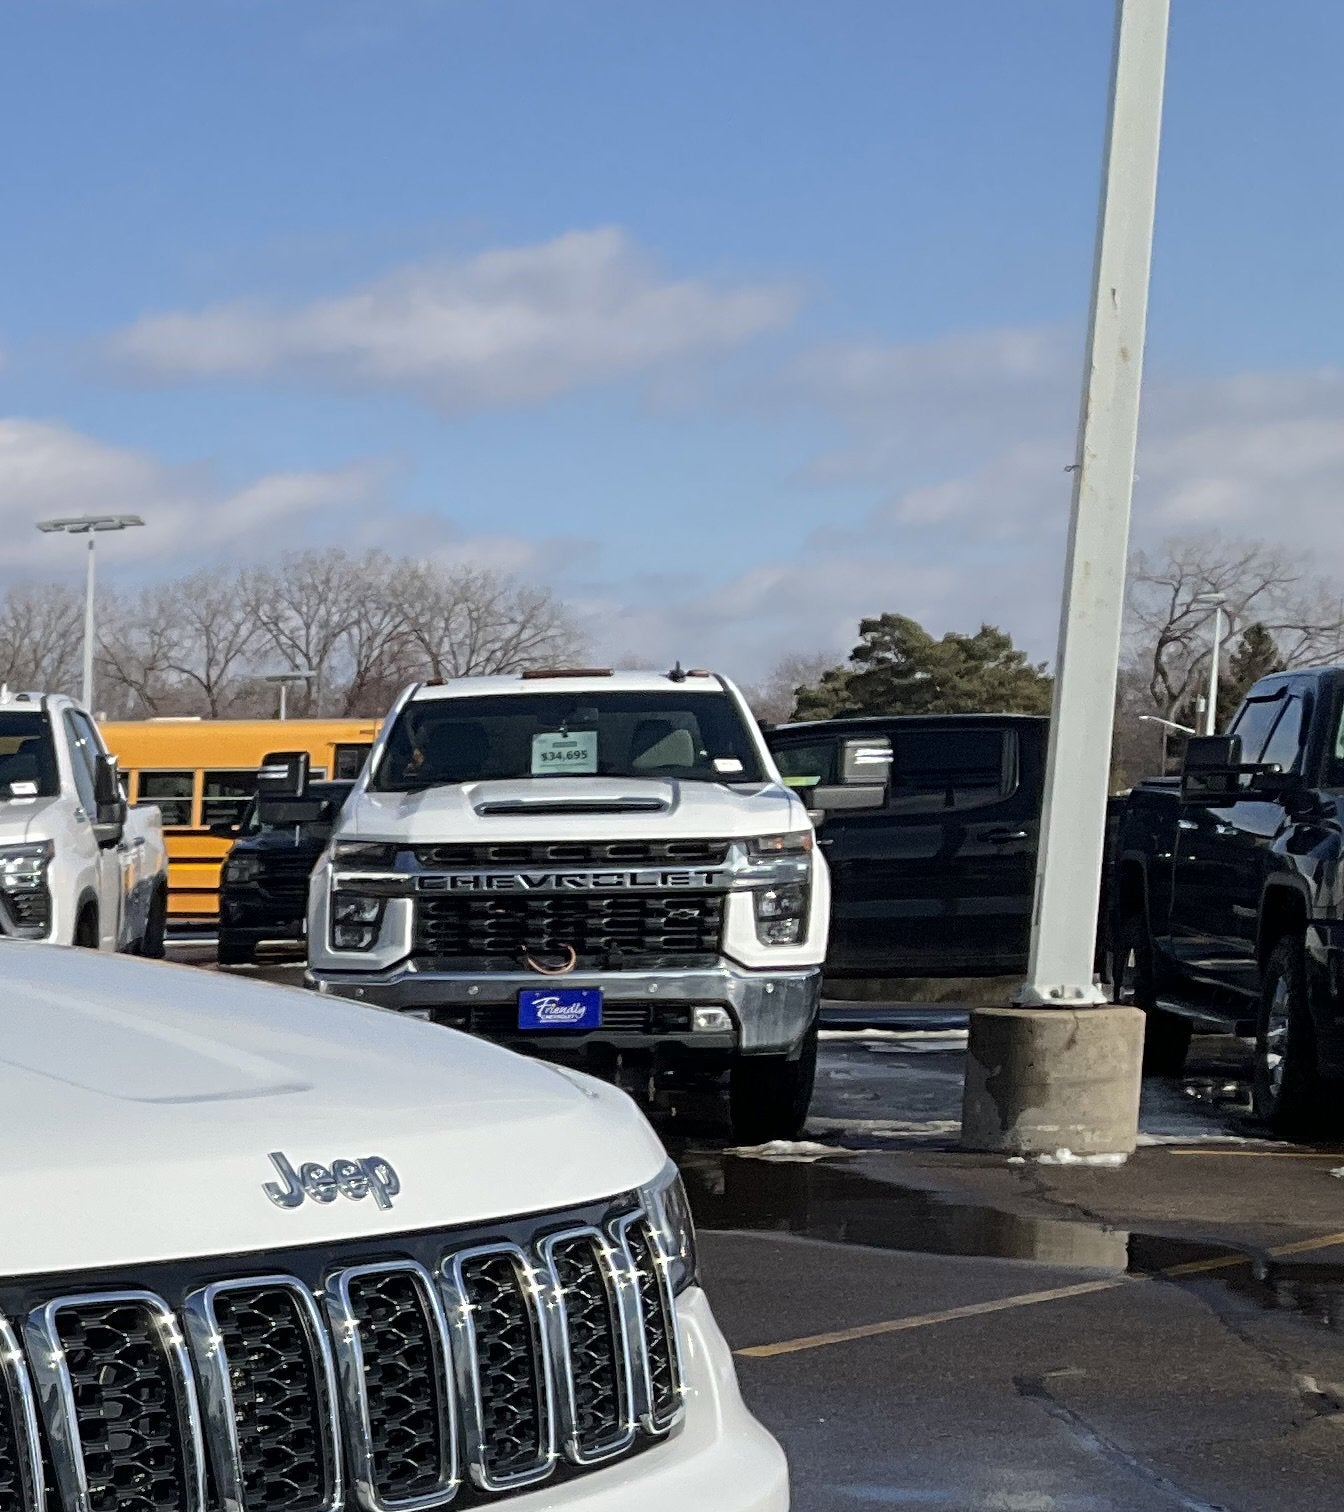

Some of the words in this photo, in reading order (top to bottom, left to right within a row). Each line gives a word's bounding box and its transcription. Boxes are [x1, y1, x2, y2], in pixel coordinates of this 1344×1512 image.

[416, 870, 725, 890] CHEVROLET
[531, 996, 586, 1019] Friendly
[261, 1151, 401, 1211] Jeep
